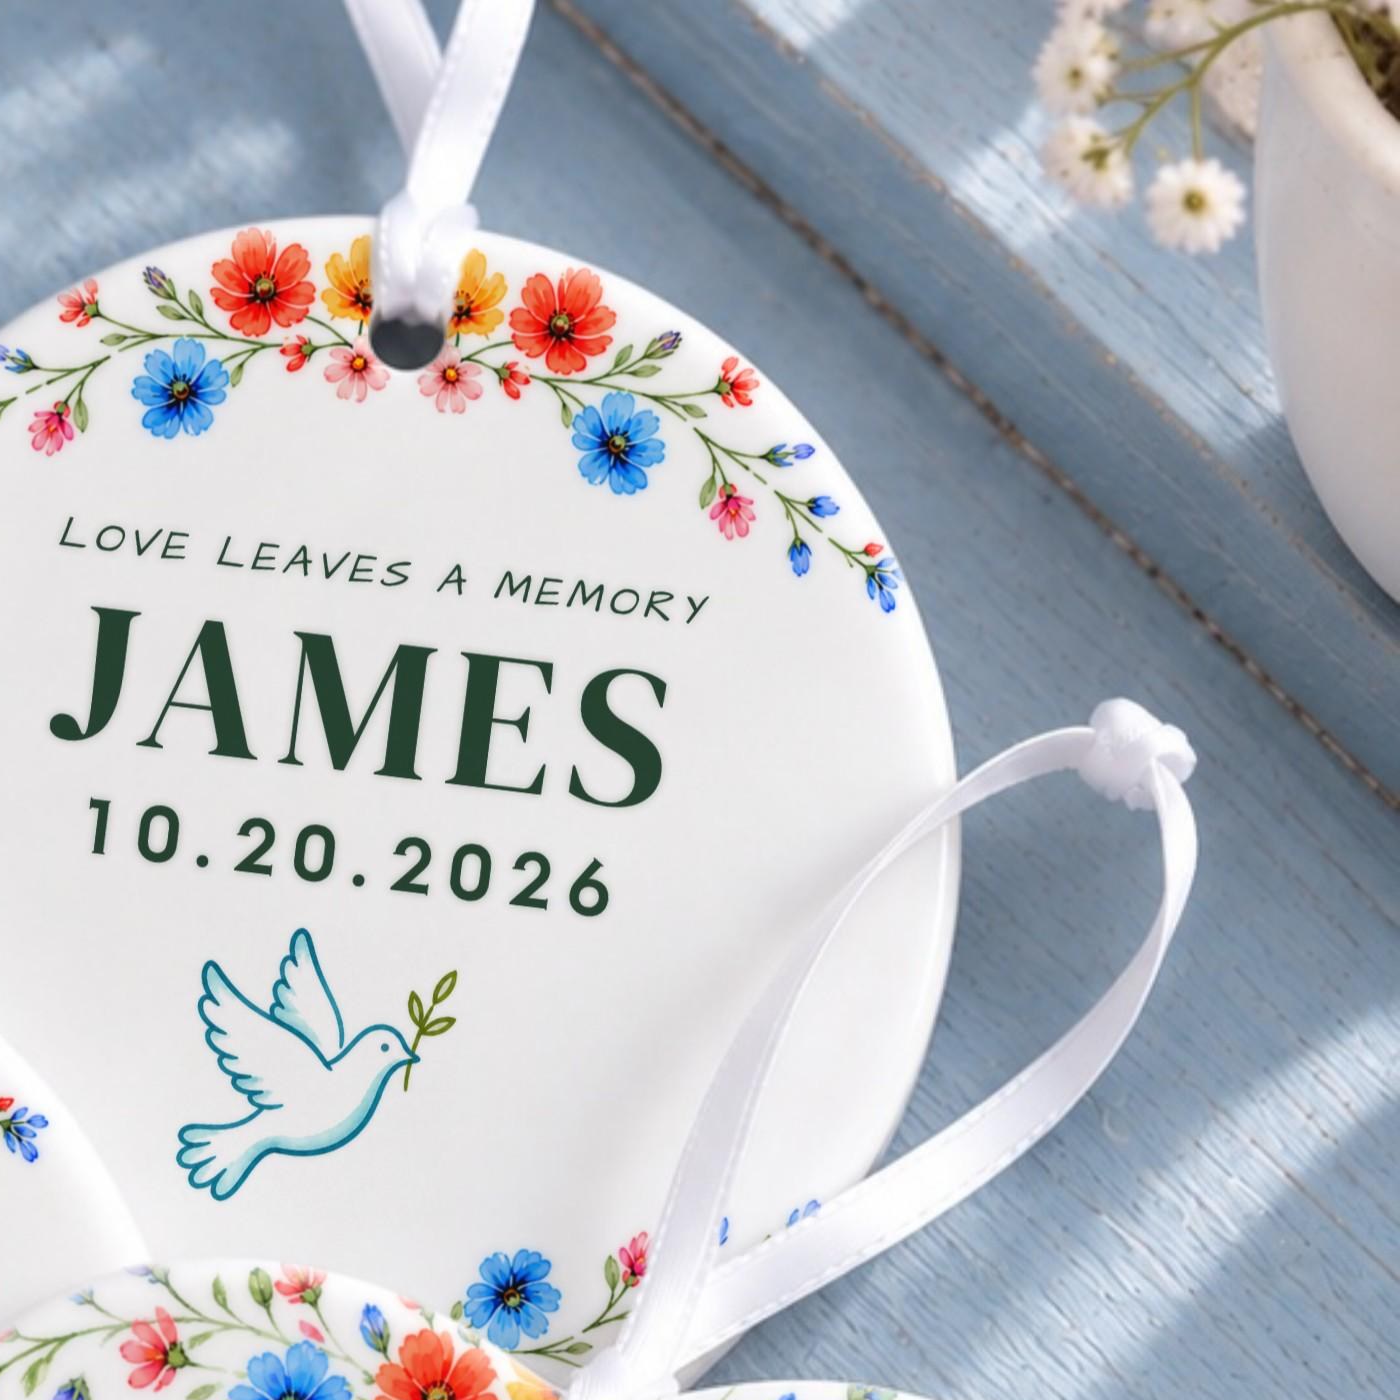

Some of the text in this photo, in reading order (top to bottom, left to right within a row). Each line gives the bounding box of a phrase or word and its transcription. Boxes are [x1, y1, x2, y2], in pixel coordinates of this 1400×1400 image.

[58, 516, 710, 625] LOVE LEAVES A MEMORY
[49, 605, 667, 808] JAMES
[89, 796, 611, 918] 10.20.2026
